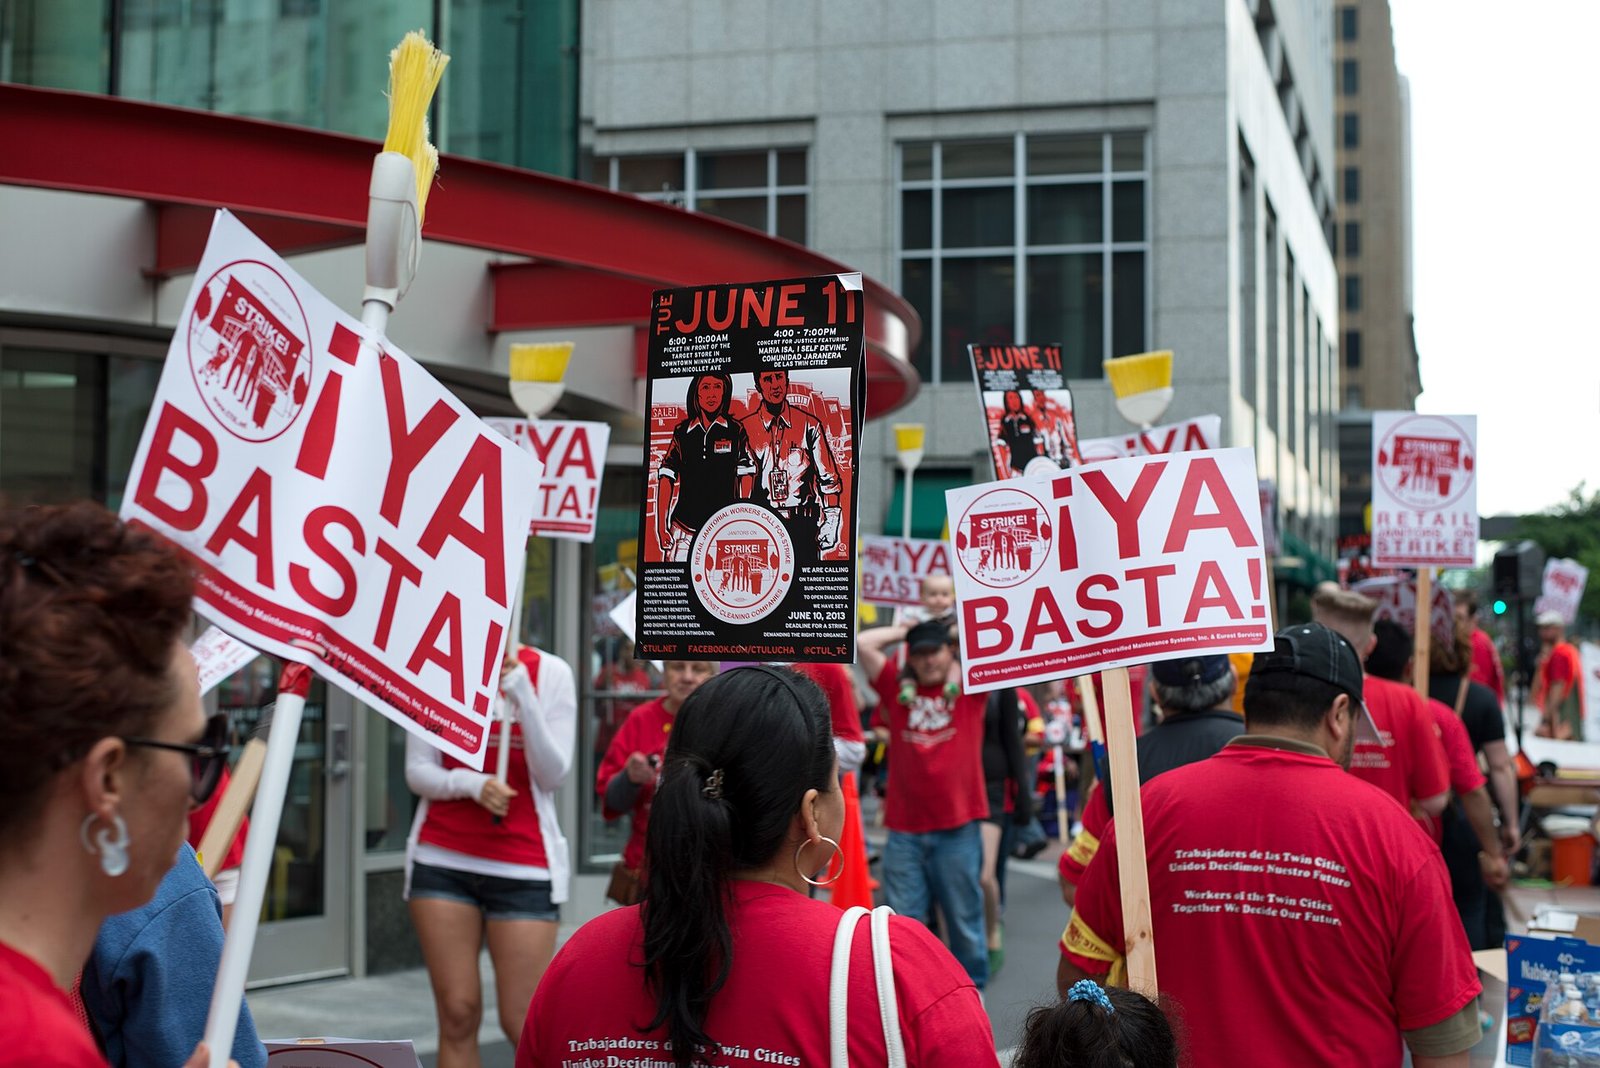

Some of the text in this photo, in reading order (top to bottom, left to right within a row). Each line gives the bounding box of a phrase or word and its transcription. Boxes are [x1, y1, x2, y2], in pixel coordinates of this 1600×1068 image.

[656, 294, 673, 335] TUE
[675, 281, 856, 334] JUNE 11
[234, 297, 291, 355] STRIKE!
[774, 328, 837, 338] 4:00 7:00PM
[664, 346, 684, 354] PICKET
[668, 334, 728, 346] 6:00 10:00AM
[758, 344, 848, 354] MARIA ISA, SELF DEVINE,
[672, 352, 693, 360] TARGET
[694, 356, 732, 366] MINNEAPOLIS
[762, 352, 842, 362] COMUNIDAD JARANERA
[985, 346, 1062, 370] JUNE 11
[652, 407, 676, 418] SALE!
[295, 322, 508, 610] ¡YA
[980, 514, 1028, 529] STRIKE!
[1051, 457, 1259, 572] ¡YA
[1378, 512, 1472, 526] RETAIL
[695, 507, 791, 566] RETAIL JANITORIAL WORKERS CALL FOR STRIKE
[134, 400, 503, 718] BASTA!
[724, 544, 760, 554] STRIKE!
[863, 573, 925, 598] BAST
[700, 588, 783, 620] AGAINST CLEANING COMPANIES
[962, 558, 1266, 661] BASTA!
[788, 612, 846, 621] JUNE 10, 2013
[804, 646, 848, 656] @CTUL_TC
[984, 669, 1000, 677] Strike
[1023, 661, 1044, 670] Carlson
[1044, 657, 1067, 667] Building
[1068, 651, 1102, 662] Maintenance,
[1102, 644, 1132, 655] Diversified
[1132, 638, 1168, 650] Maintenance
[1170, 636, 1197, 645] Systems,
[1216, 632, 1236, 640] Eurest
[223, 590, 254, 616] Building
[254, 608, 315, 640] Maintenance,
[347, 654, 386, 686] Maintenance
[385, 680, 412, 704] Systems,
[412, 698, 424, 713] Inc.
[429, 709, 451, 728] Eurest
[450, 721, 478, 744] Services
[1175, 848, 1247, 860] Trabajadores
[1249, 850, 1262, 860] de
[1282, 852, 1312, 866] Twin
[1314, 857, 1346, 874] Cities
[1169, 861, 1352, 888] Unidos Decidimos Nuestro Futuro
[1172, 903, 1222, 914] Together
[1224, 904, 1241, 914] We
[1242, 904, 1278, 917] Decide
[1280, 908, 1302, 920] Our
[1184, 890, 1232, 900] Workers
[1234, 891, 1246, 901] of
[1266, 893, 1297, 906] Twin
[1299, 898, 1333, 912] Cities
[562, 1058, 605, 1068] Unidos
[606, 1055, 677, 1068] Decidimo
[568, 1036, 659, 1052] Trabajadores
[754, 1048, 800, 1067] Cities
